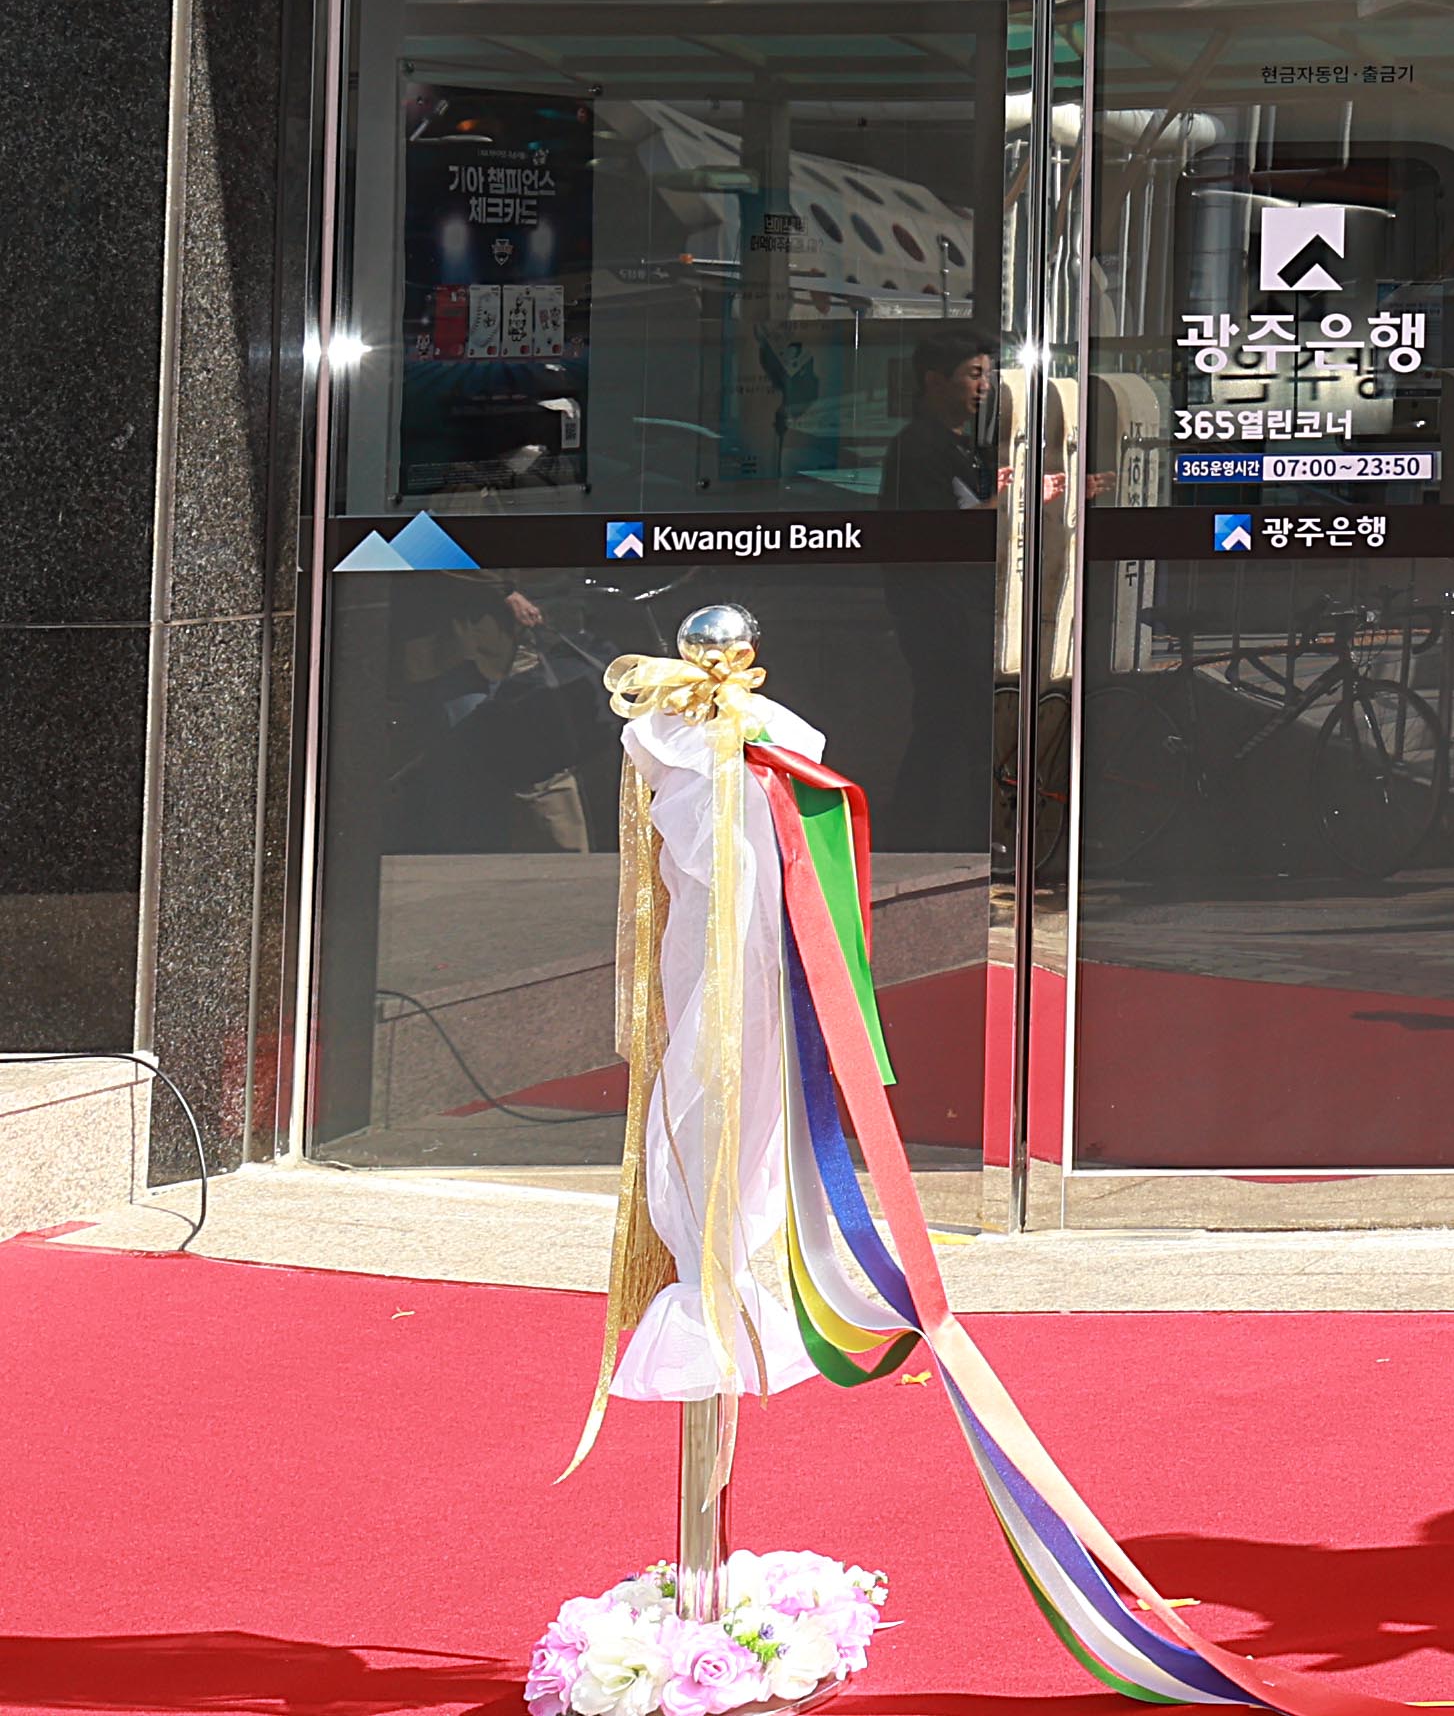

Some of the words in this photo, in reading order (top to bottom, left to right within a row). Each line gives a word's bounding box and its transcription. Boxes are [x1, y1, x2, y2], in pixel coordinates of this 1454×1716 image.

[447, 164, 485, 193] 기아
[487, 166, 556, 196] 챔피언스
[468, 195, 538, 225] 체크카드
[1176, 311, 1426, 374] 광주은행
[1174, 409, 1353, 441] 365열린코너
[1182, 459, 1260, 477] 365운영시간
[653, 524, 782, 559] Kwangju
[789, 522, 862, 550] Bank
[1262, 515, 1387, 548] 광주은행
